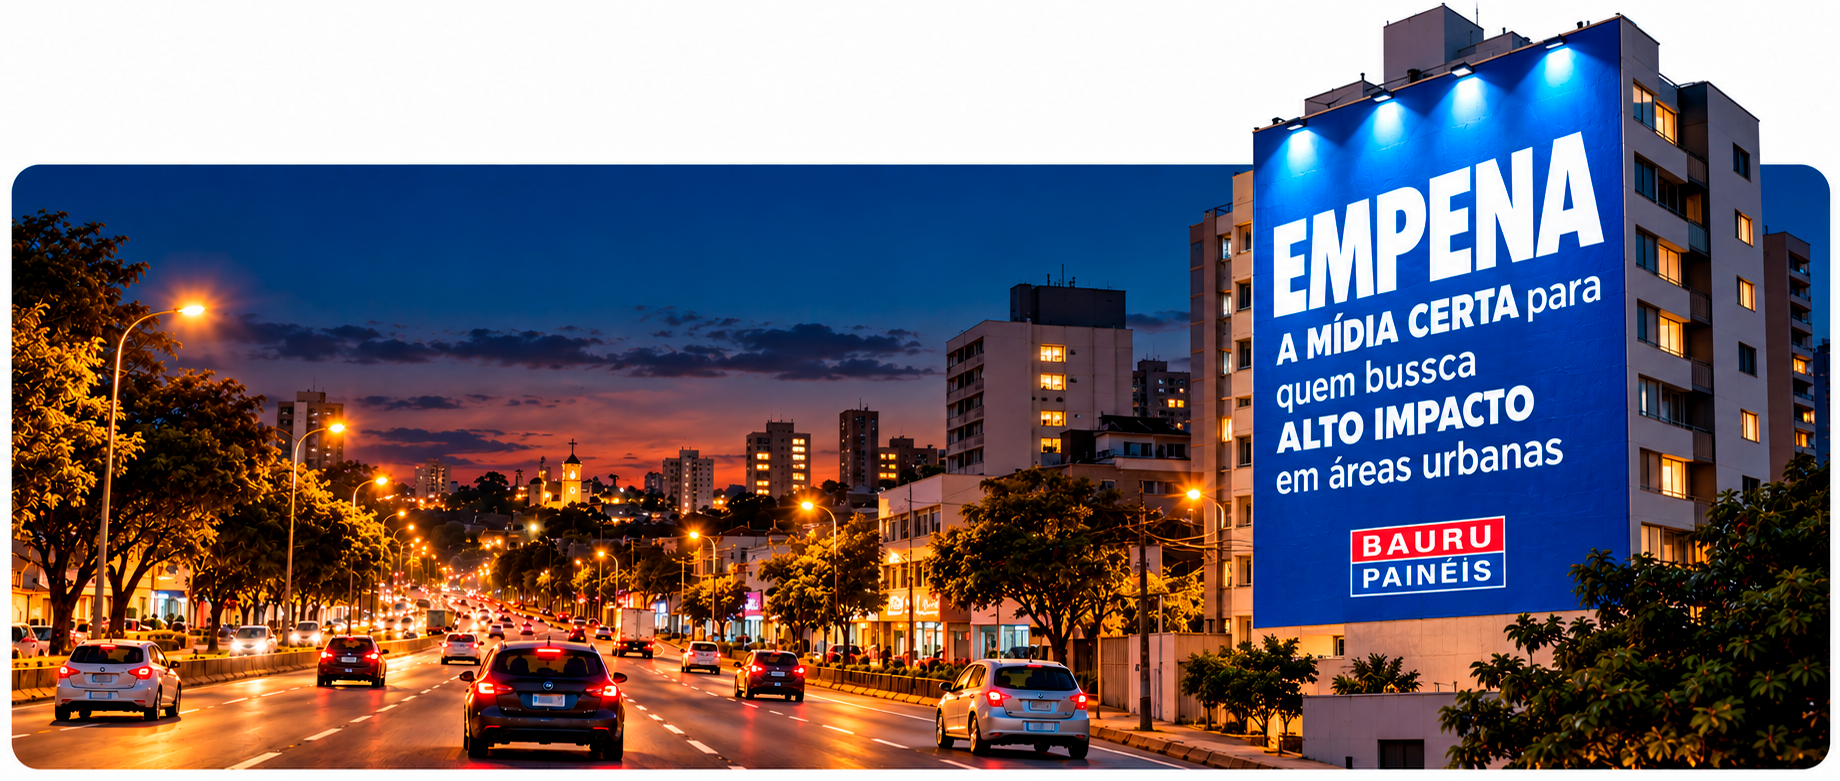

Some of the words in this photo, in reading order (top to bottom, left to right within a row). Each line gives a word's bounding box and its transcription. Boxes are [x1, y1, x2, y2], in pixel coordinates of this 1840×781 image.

[1273, 131, 1604, 318] EMPENA
[1276, 332, 1299, 366] A
[1307, 312, 1399, 360] MÍDIA
[1408, 284, 1520, 338] CERTA
[1527, 275, 1601, 322] para
[1276, 372, 1355, 414] quem
[1365, 351, 1476, 394] bussca
[1276, 411, 1364, 454] ALTO
[1374, 384, 1535, 441] IMPACTO
[1276, 467, 1319, 495] em
[1328, 454, 1412, 490] áreas
[1422, 437, 1564, 479] urbanas
[1362, 524, 1491, 558] BAURU
